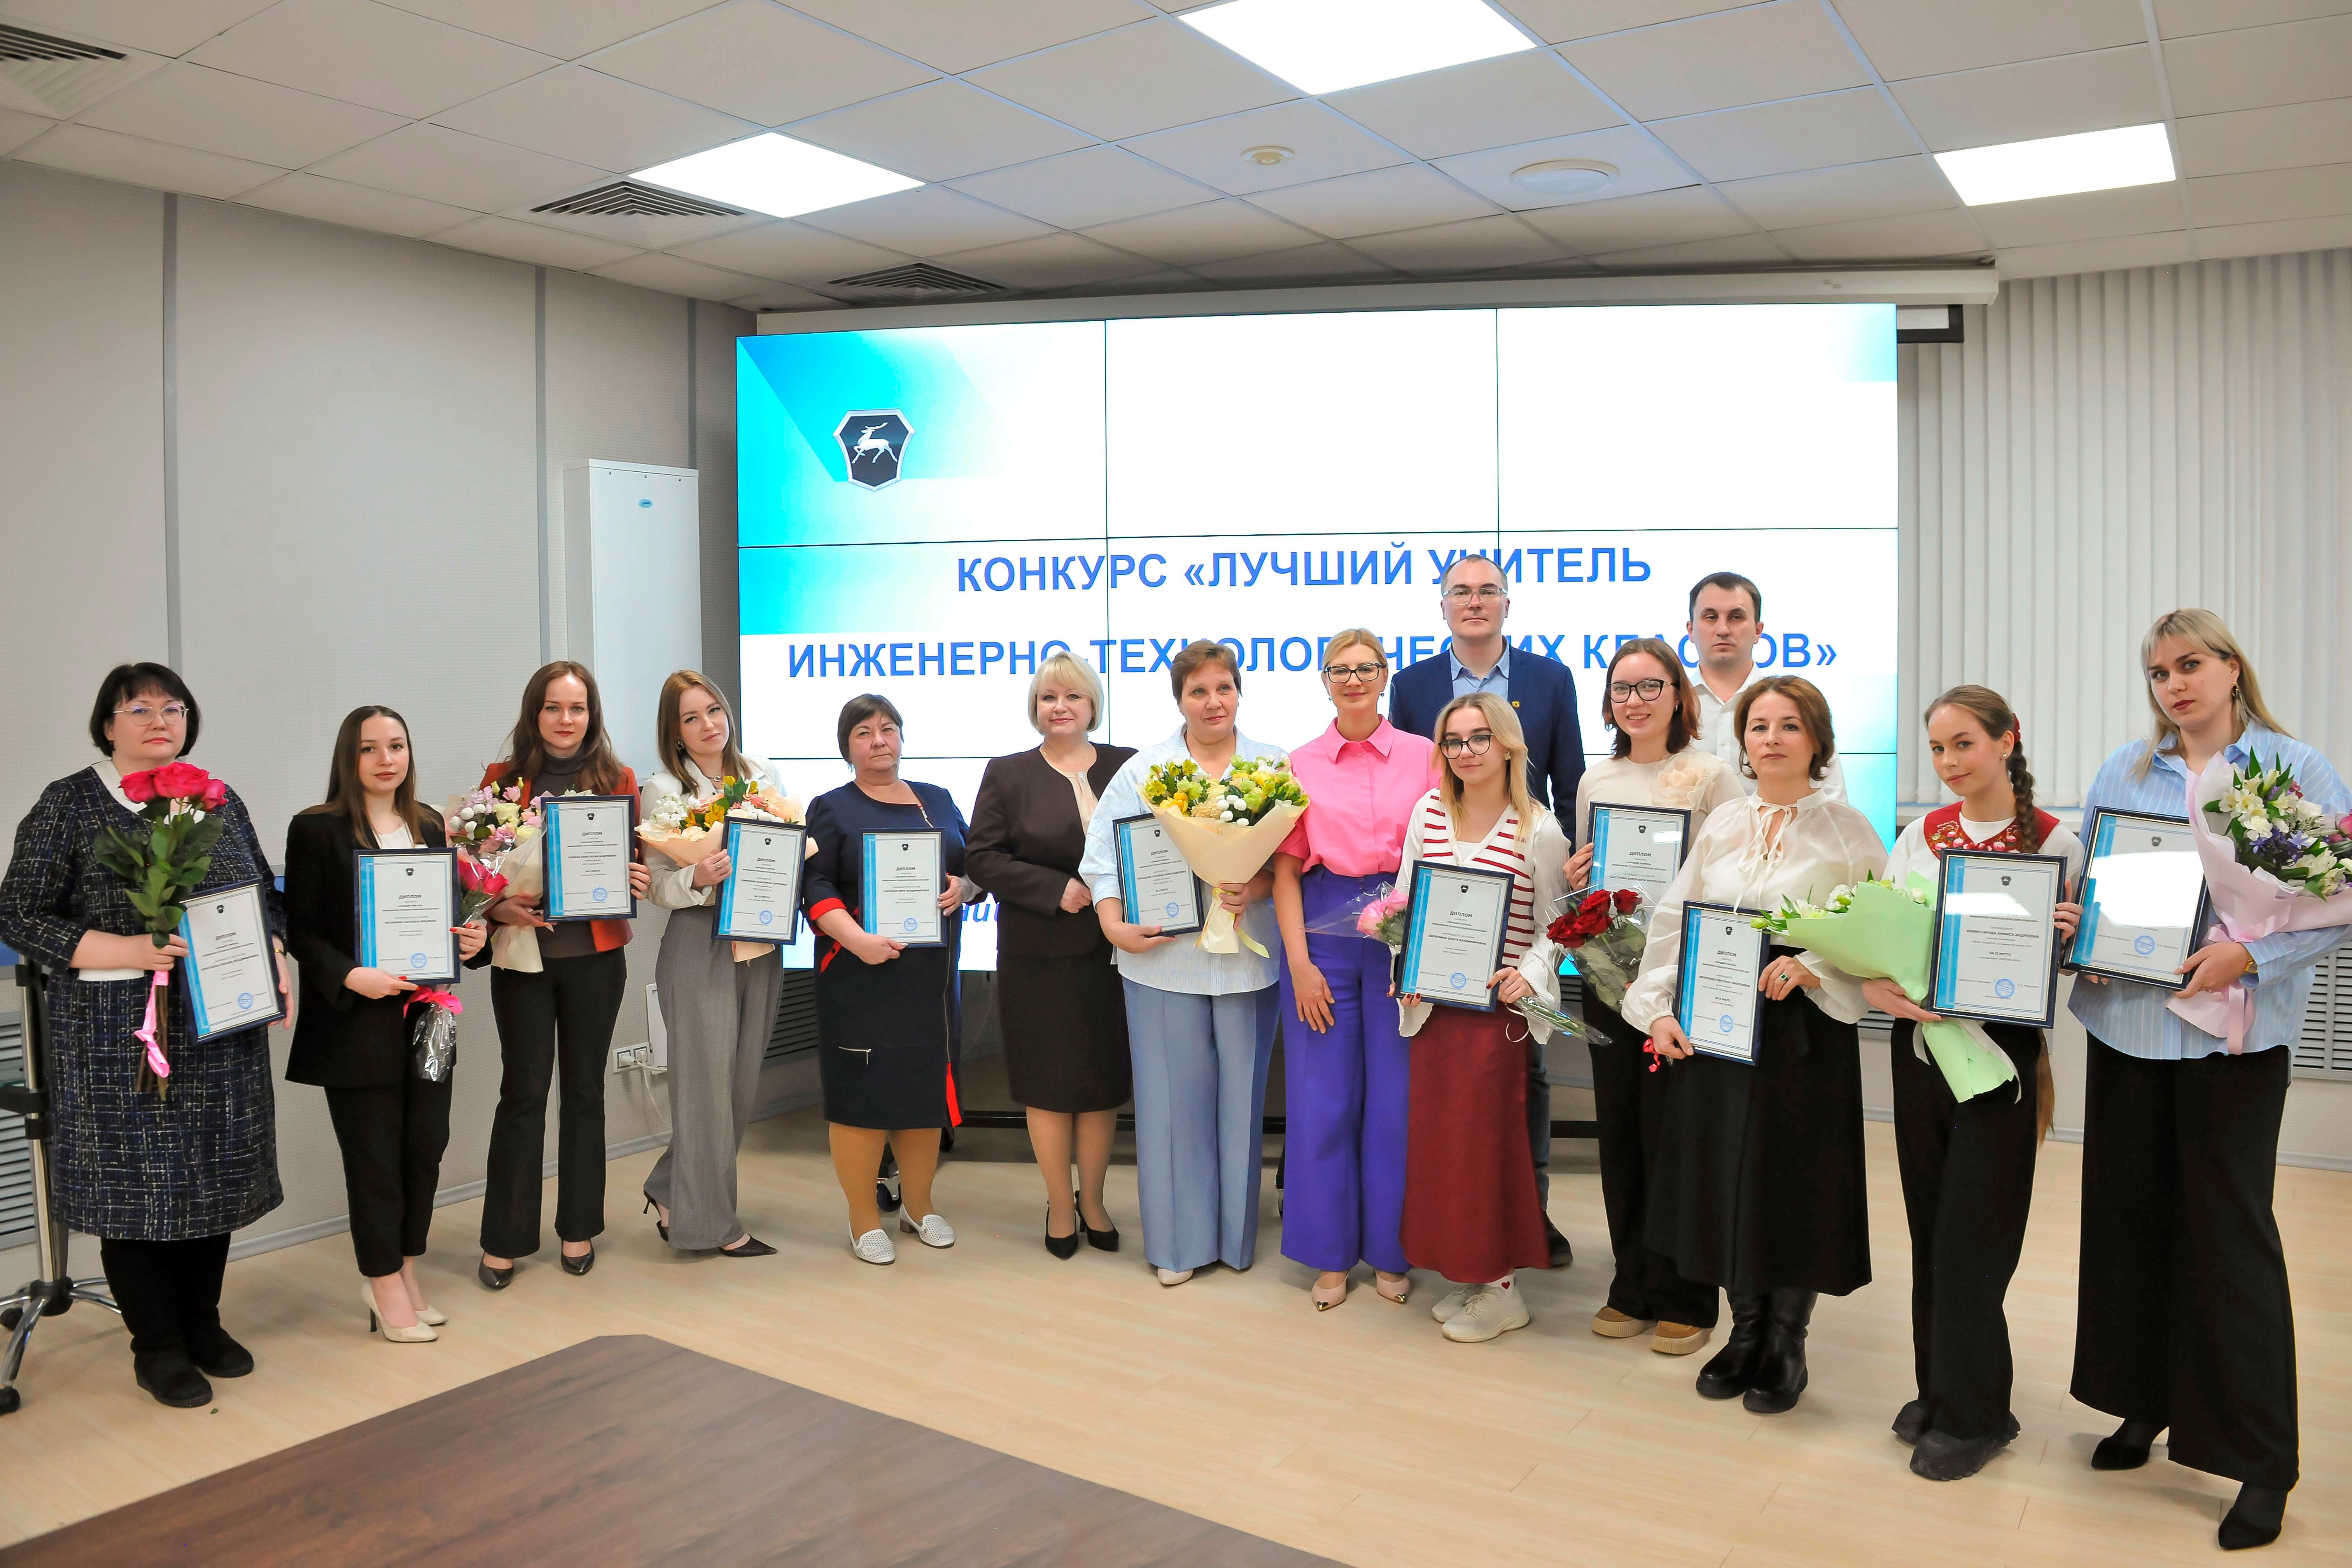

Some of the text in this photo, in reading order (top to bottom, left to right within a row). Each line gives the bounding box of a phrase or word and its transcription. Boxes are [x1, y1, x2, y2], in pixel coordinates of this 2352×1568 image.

[958, 541, 1651, 592] КОНКУРС «ЛУЧШИЙ УИТЕЛЬ
[1584, 633, 1837, 669] КСОВ»
[215, 932, 236, 940] ДИПЛОМ
